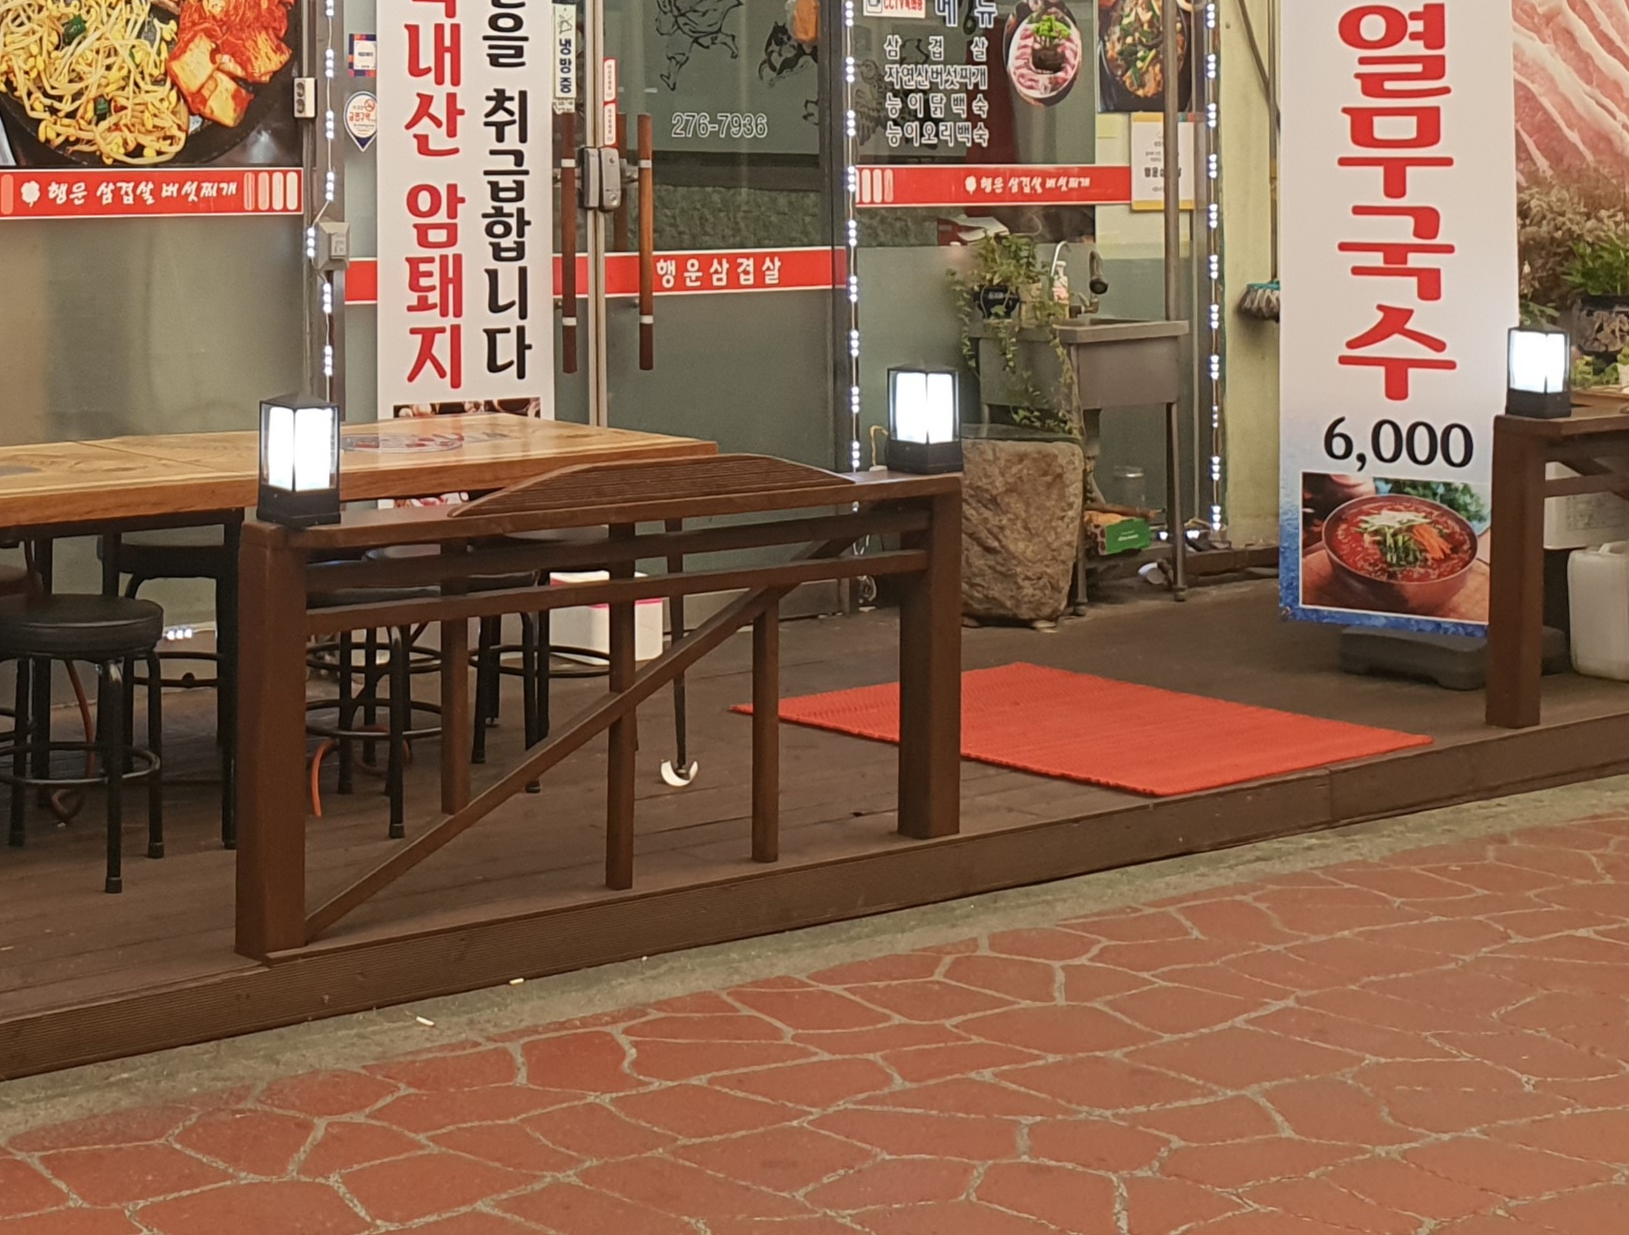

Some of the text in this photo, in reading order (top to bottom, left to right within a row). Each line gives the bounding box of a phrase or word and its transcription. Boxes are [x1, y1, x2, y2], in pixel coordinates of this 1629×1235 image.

[671, 112, 769, 139] 276-7936
[47, 179, 238, 206] 행운 삼겹살 버섯찌개
[480, 87, 533, 380] 취급합니다
[1336, 2, 1457, 401] 열무국수
[404, 182, 466, 390] 암퇘지
[1323, 417, 1474, 471] 6,000
